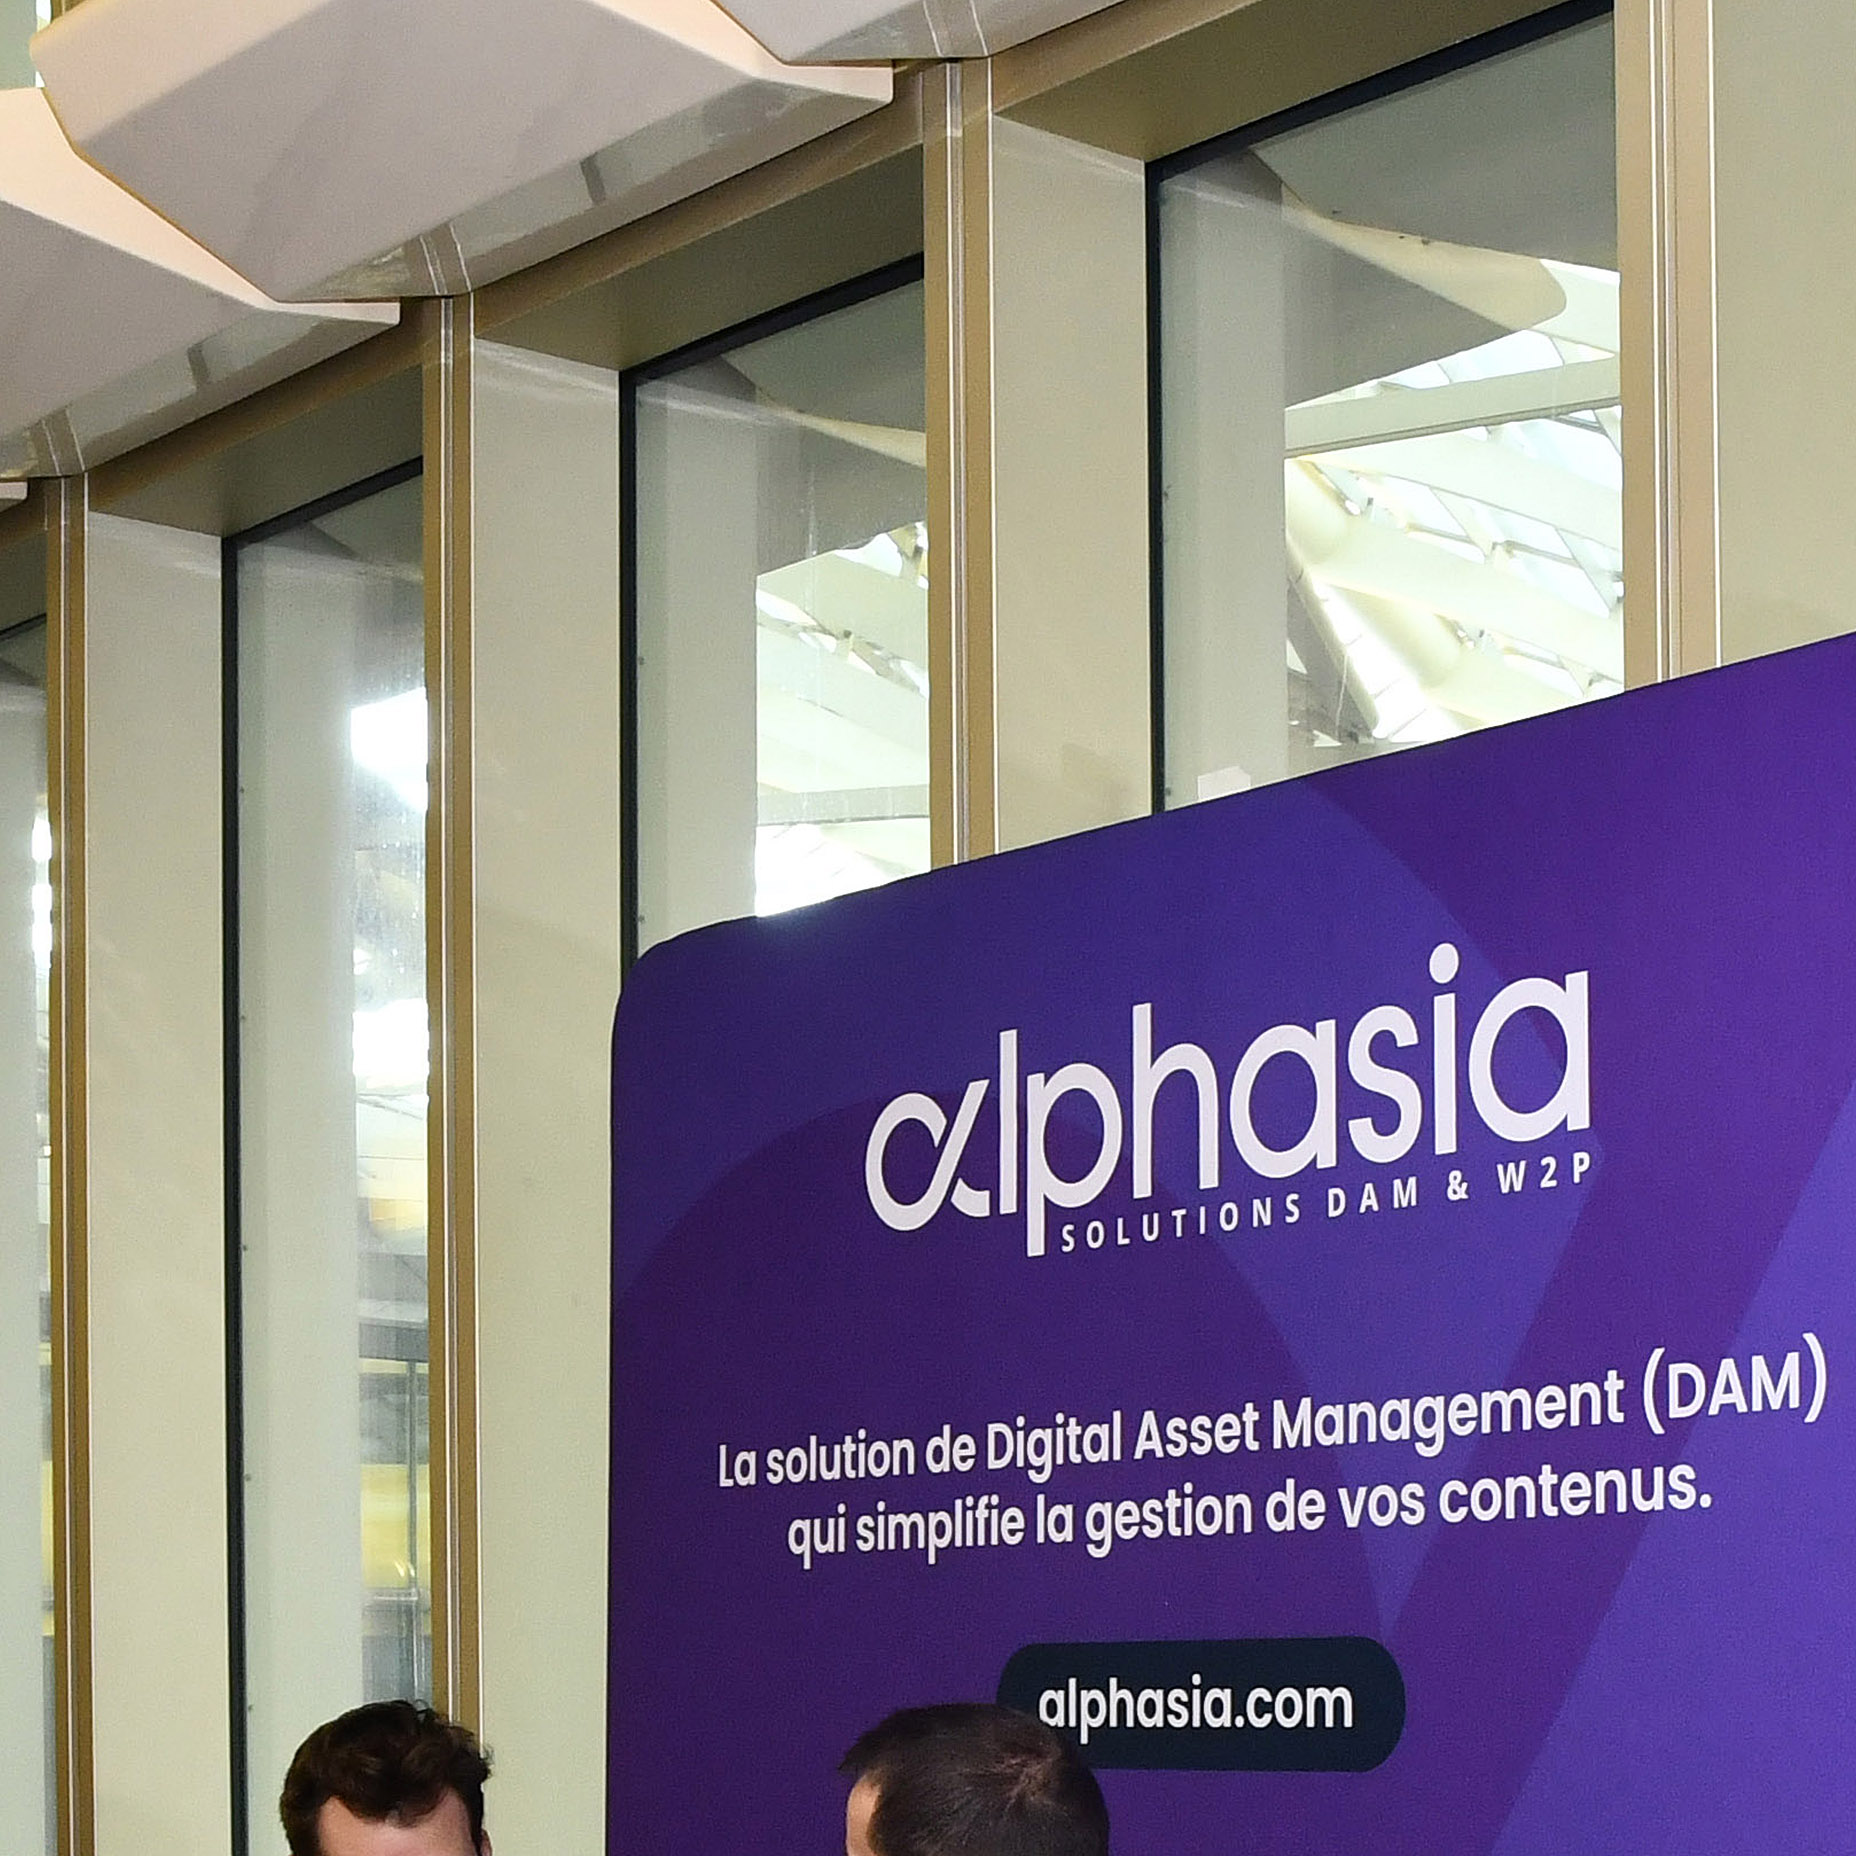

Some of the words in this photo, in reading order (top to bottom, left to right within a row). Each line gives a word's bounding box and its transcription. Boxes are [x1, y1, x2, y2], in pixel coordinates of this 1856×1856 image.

[865, 942, 1591, 1258] alphasia
[1061, 1193, 1300, 1253] SOLUTIONS
[1327, 1176, 1417, 1218] DAM
[1446, 1170, 1469, 1201] &
[1496, 1151, 1590, 1194] W2P
[719, 1444, 757, 1487] La
[766, 1428, 915, 1485] solution
[925, 1424, 977, 1474] de
[987, 1410, 1122, 1484] Digital
[1133, 1402, 1260, 1460] Asset
[1273, 1369, 1625, 1458] Management
[1643, 1332, 1827, 1435] (DAM)
[788, 1516, 846, 1570] qui
[855, 1494, 1025, 1565] simplifie
[1036, 1493, 1074, 1544] la
[1085, 1488, 1252, 1558] gestion
[1265, 1478, 1326, 1532] de
[1337, 1482, 1426, 1528] vos
[1439, 1464, 1712, 1523] contenus.
[1038, 1673, 1353, 1745] alphasia.com
